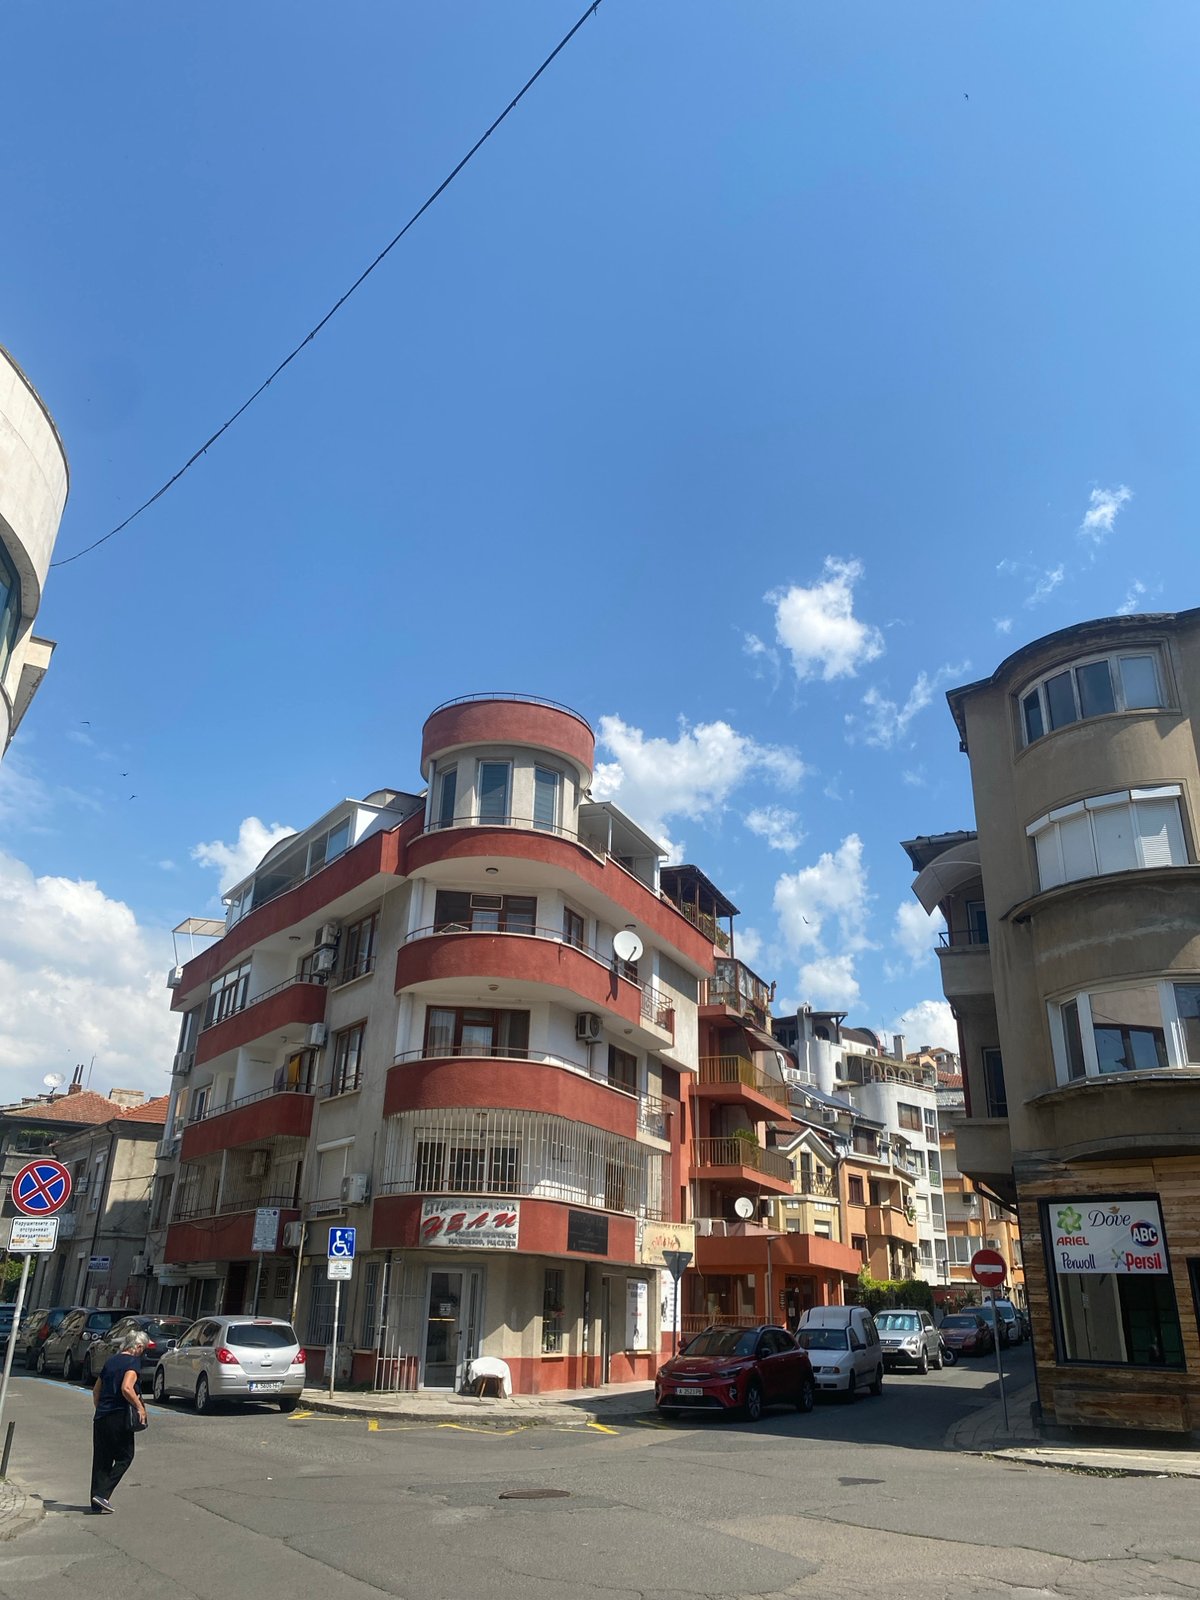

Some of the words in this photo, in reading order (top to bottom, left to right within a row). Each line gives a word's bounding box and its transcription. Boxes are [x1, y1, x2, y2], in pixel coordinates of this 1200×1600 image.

[1088, 1210, 1131, 1227] Dove
[1056, 1236, 1089, 1246] ARIEL
[1132, 1227, 1157, 1242] ABC
[1061, 1252, 1096, 1269] Perwoll
[1125, 1253, 1162, 1271] Persil
